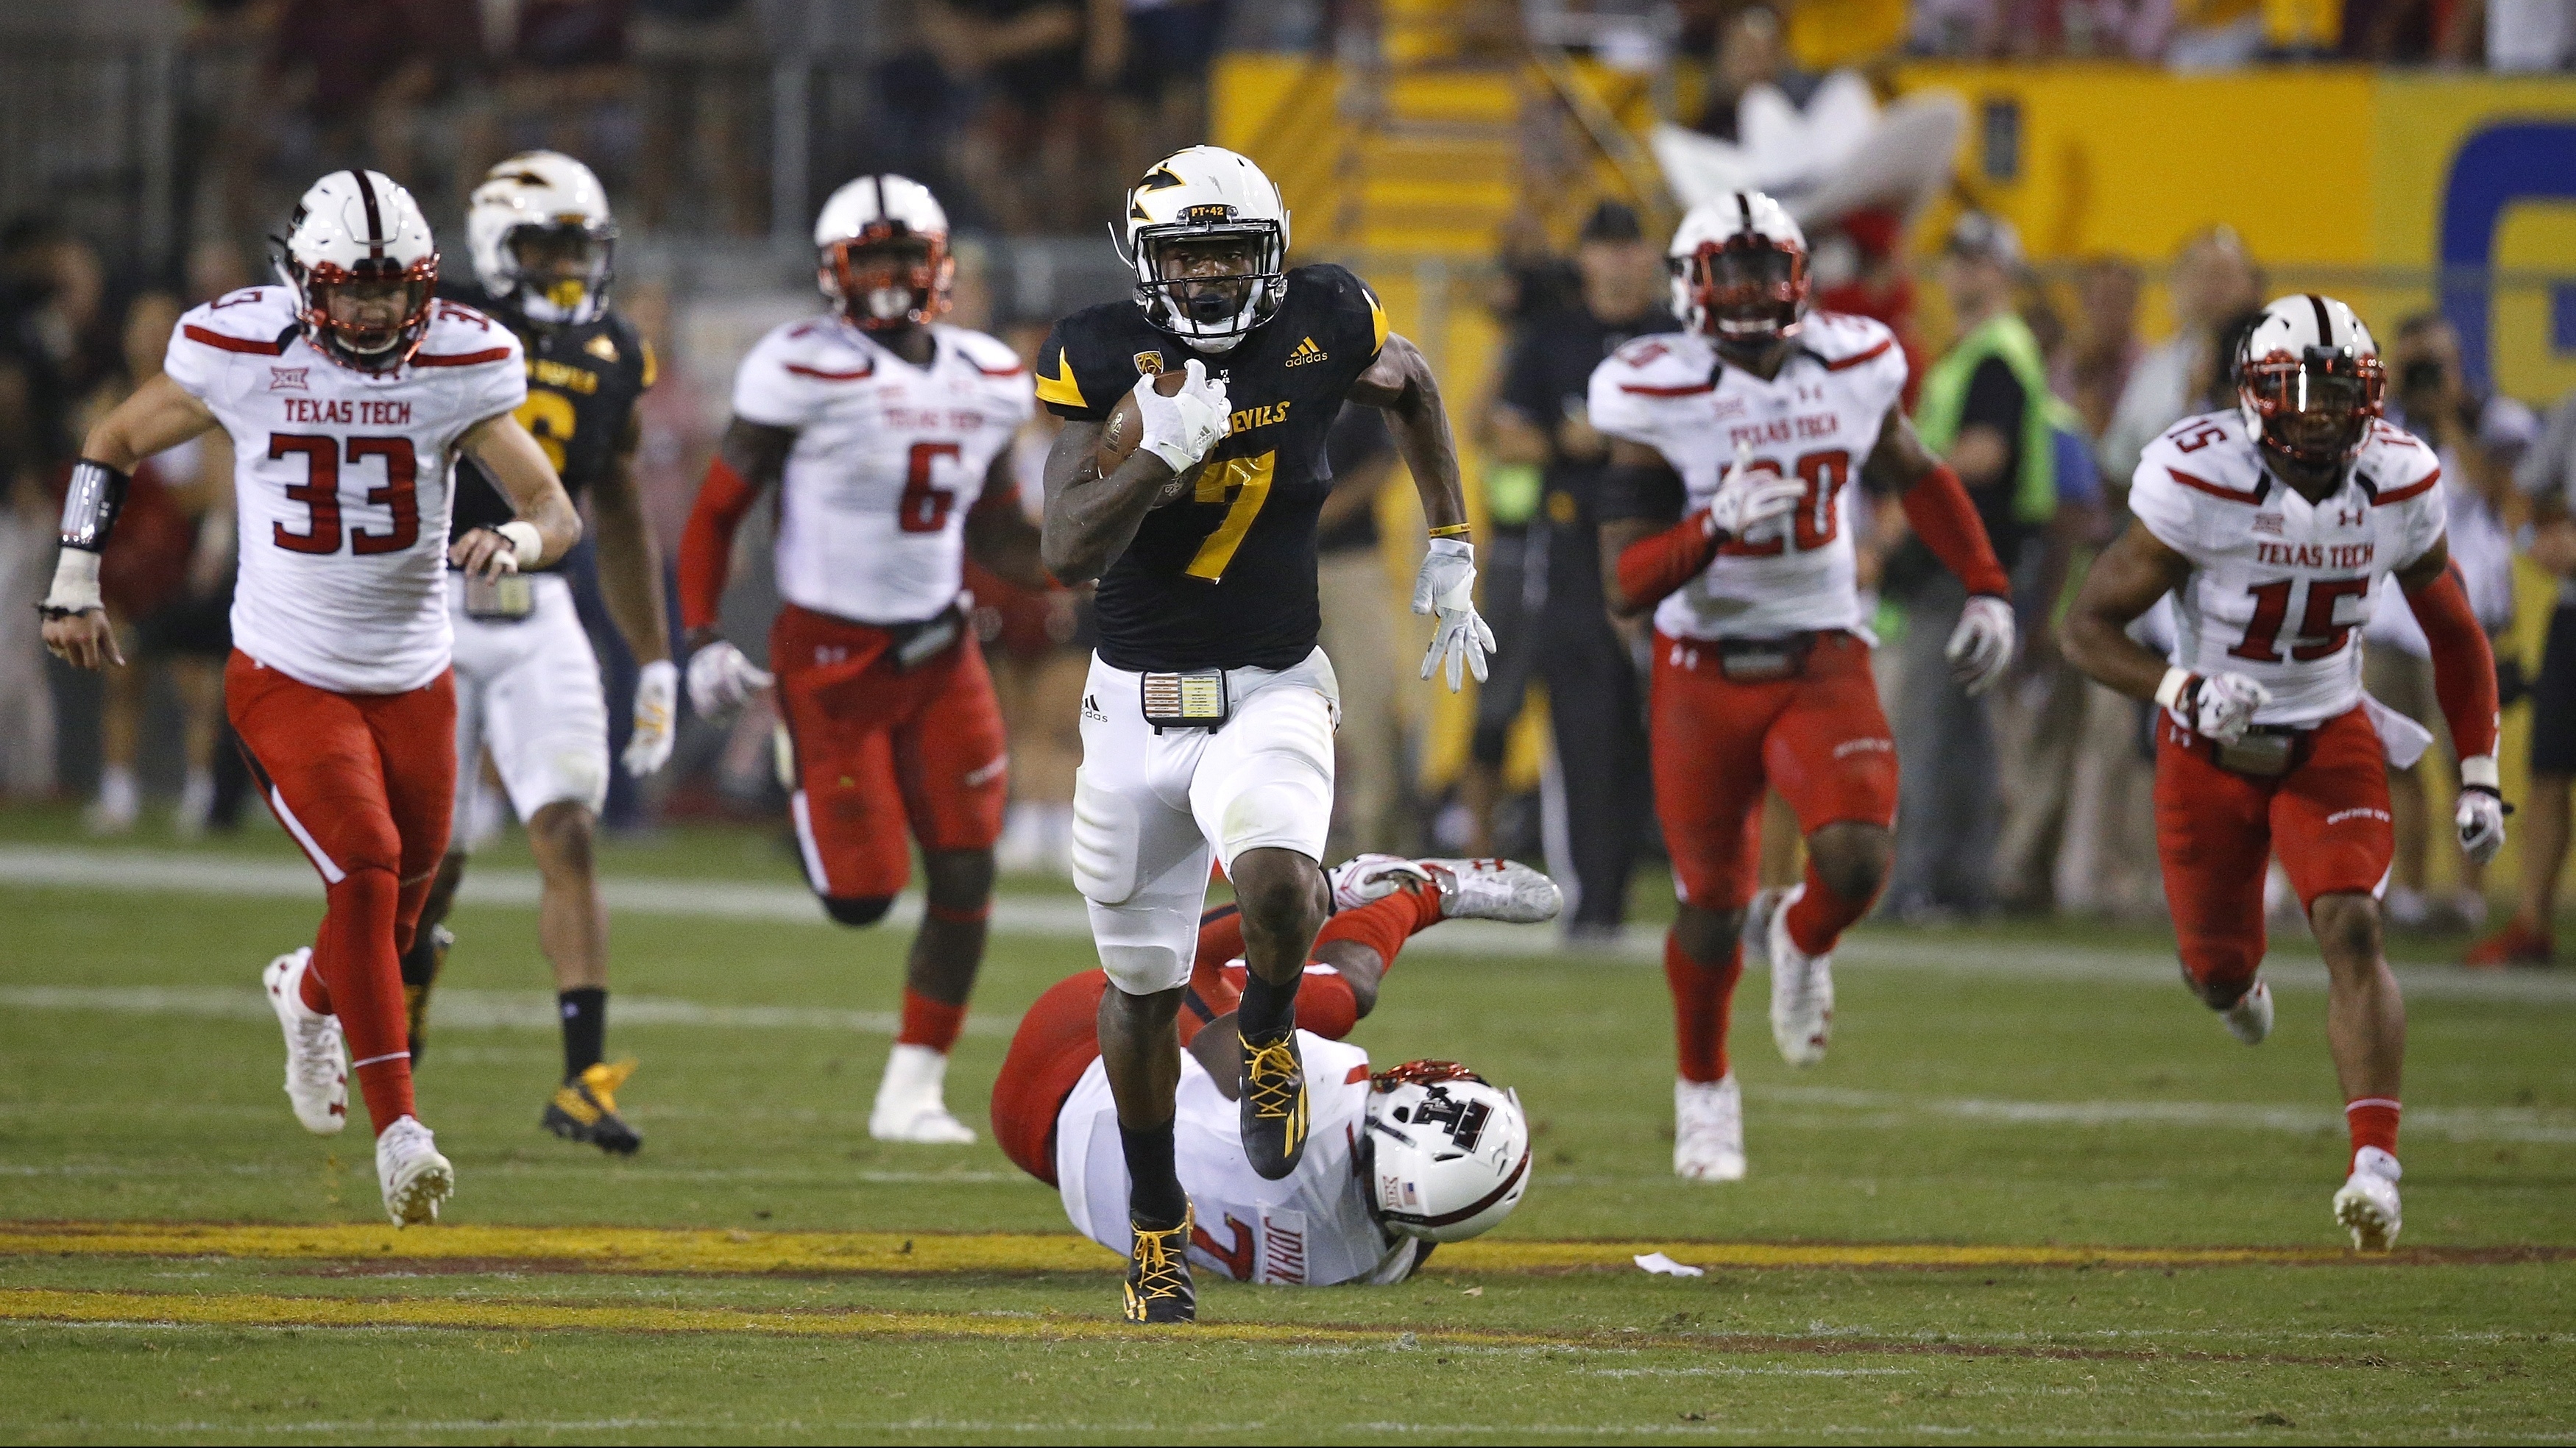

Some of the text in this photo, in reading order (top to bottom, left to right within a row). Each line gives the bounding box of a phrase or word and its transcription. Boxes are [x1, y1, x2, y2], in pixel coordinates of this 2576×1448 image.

[1285, 352, 1328, 368] adidas
[284, 397, 411, 424] TEXAS TECH
[1225, 401, 1291, 439] EVILS
[268, 433, 420, 556] 33
[899, 441, 961, 533] 6
[1184, 449, 1275, 581] 7
[2258, 542, 2374, 569] TEXAS TECH
[2228, 574, 2370, 662] 15
[1191, 1212, 1255, 1282] 7
[1263, 1215, 1305, 1285] JOHN
